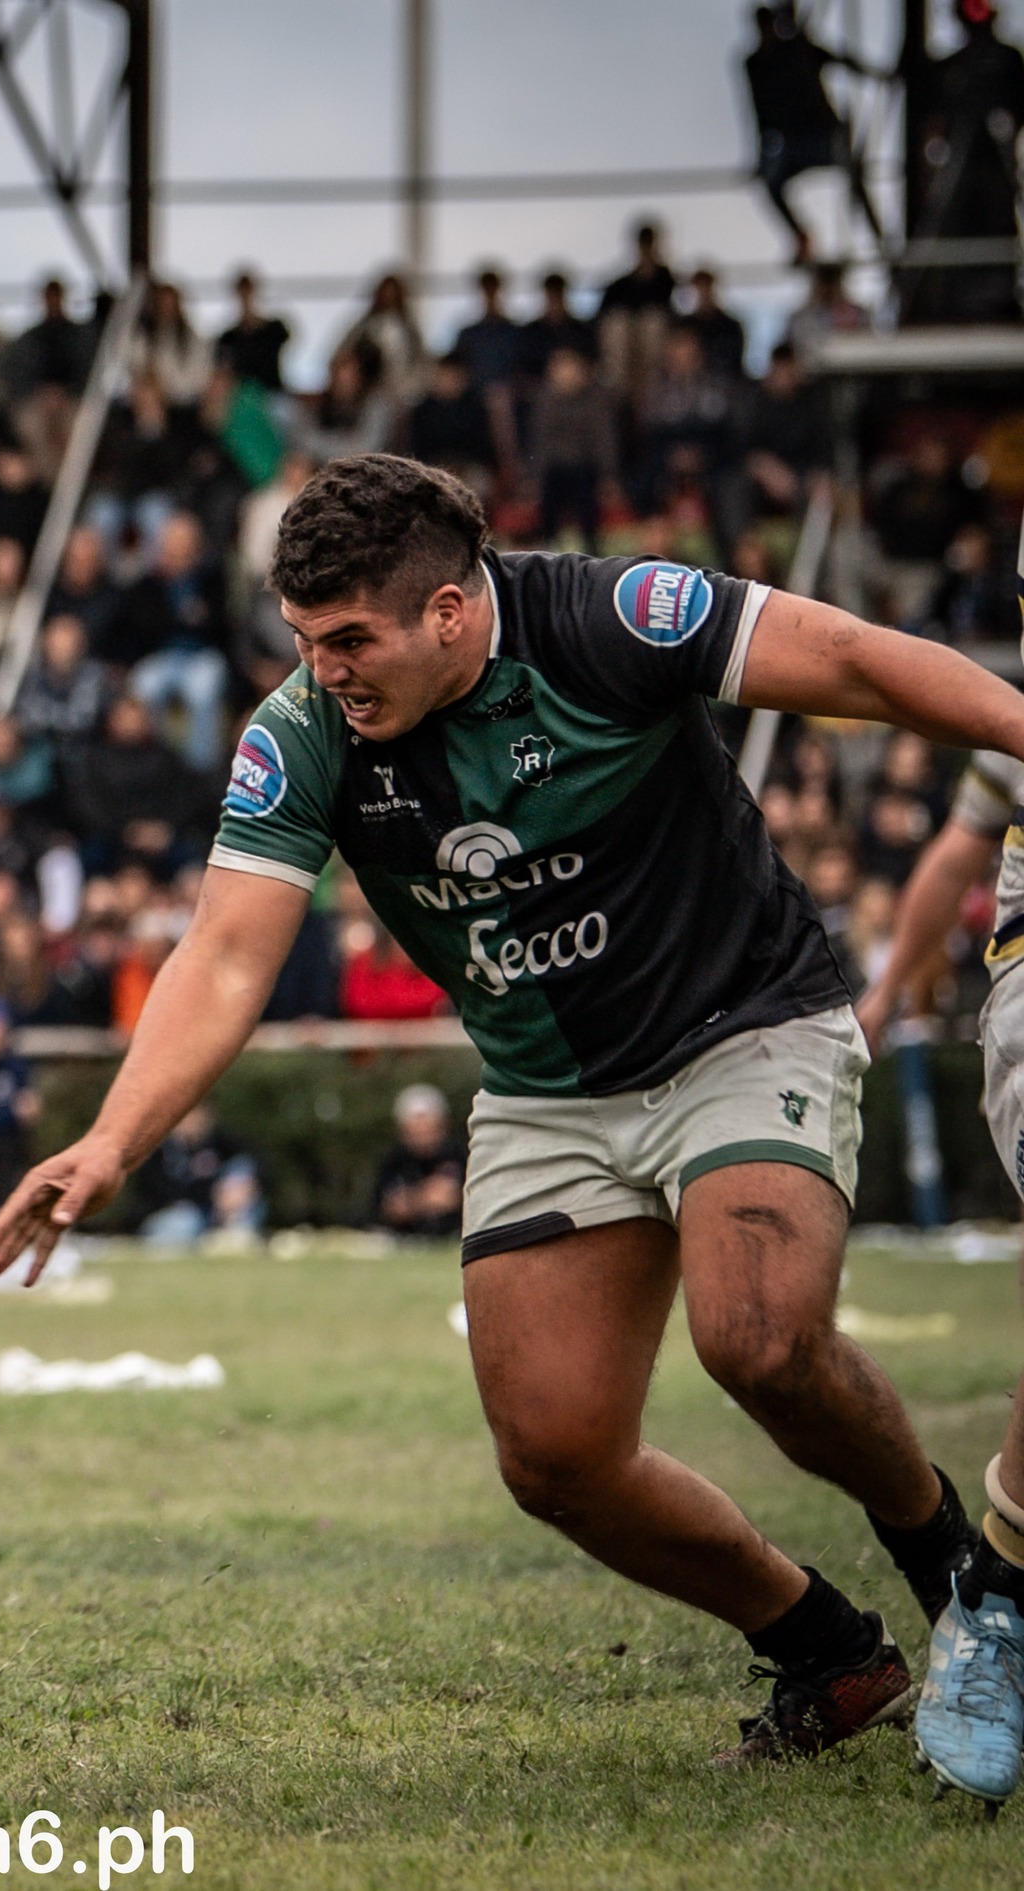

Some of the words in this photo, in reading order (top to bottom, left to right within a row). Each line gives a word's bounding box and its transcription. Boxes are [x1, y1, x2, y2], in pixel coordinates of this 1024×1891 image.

[648, 570, 684, 629] MIPOL
[524, 752, 541, 771] R
[410, 853, 584, 910] Macro
[465, 911, 608, 996] Secco
